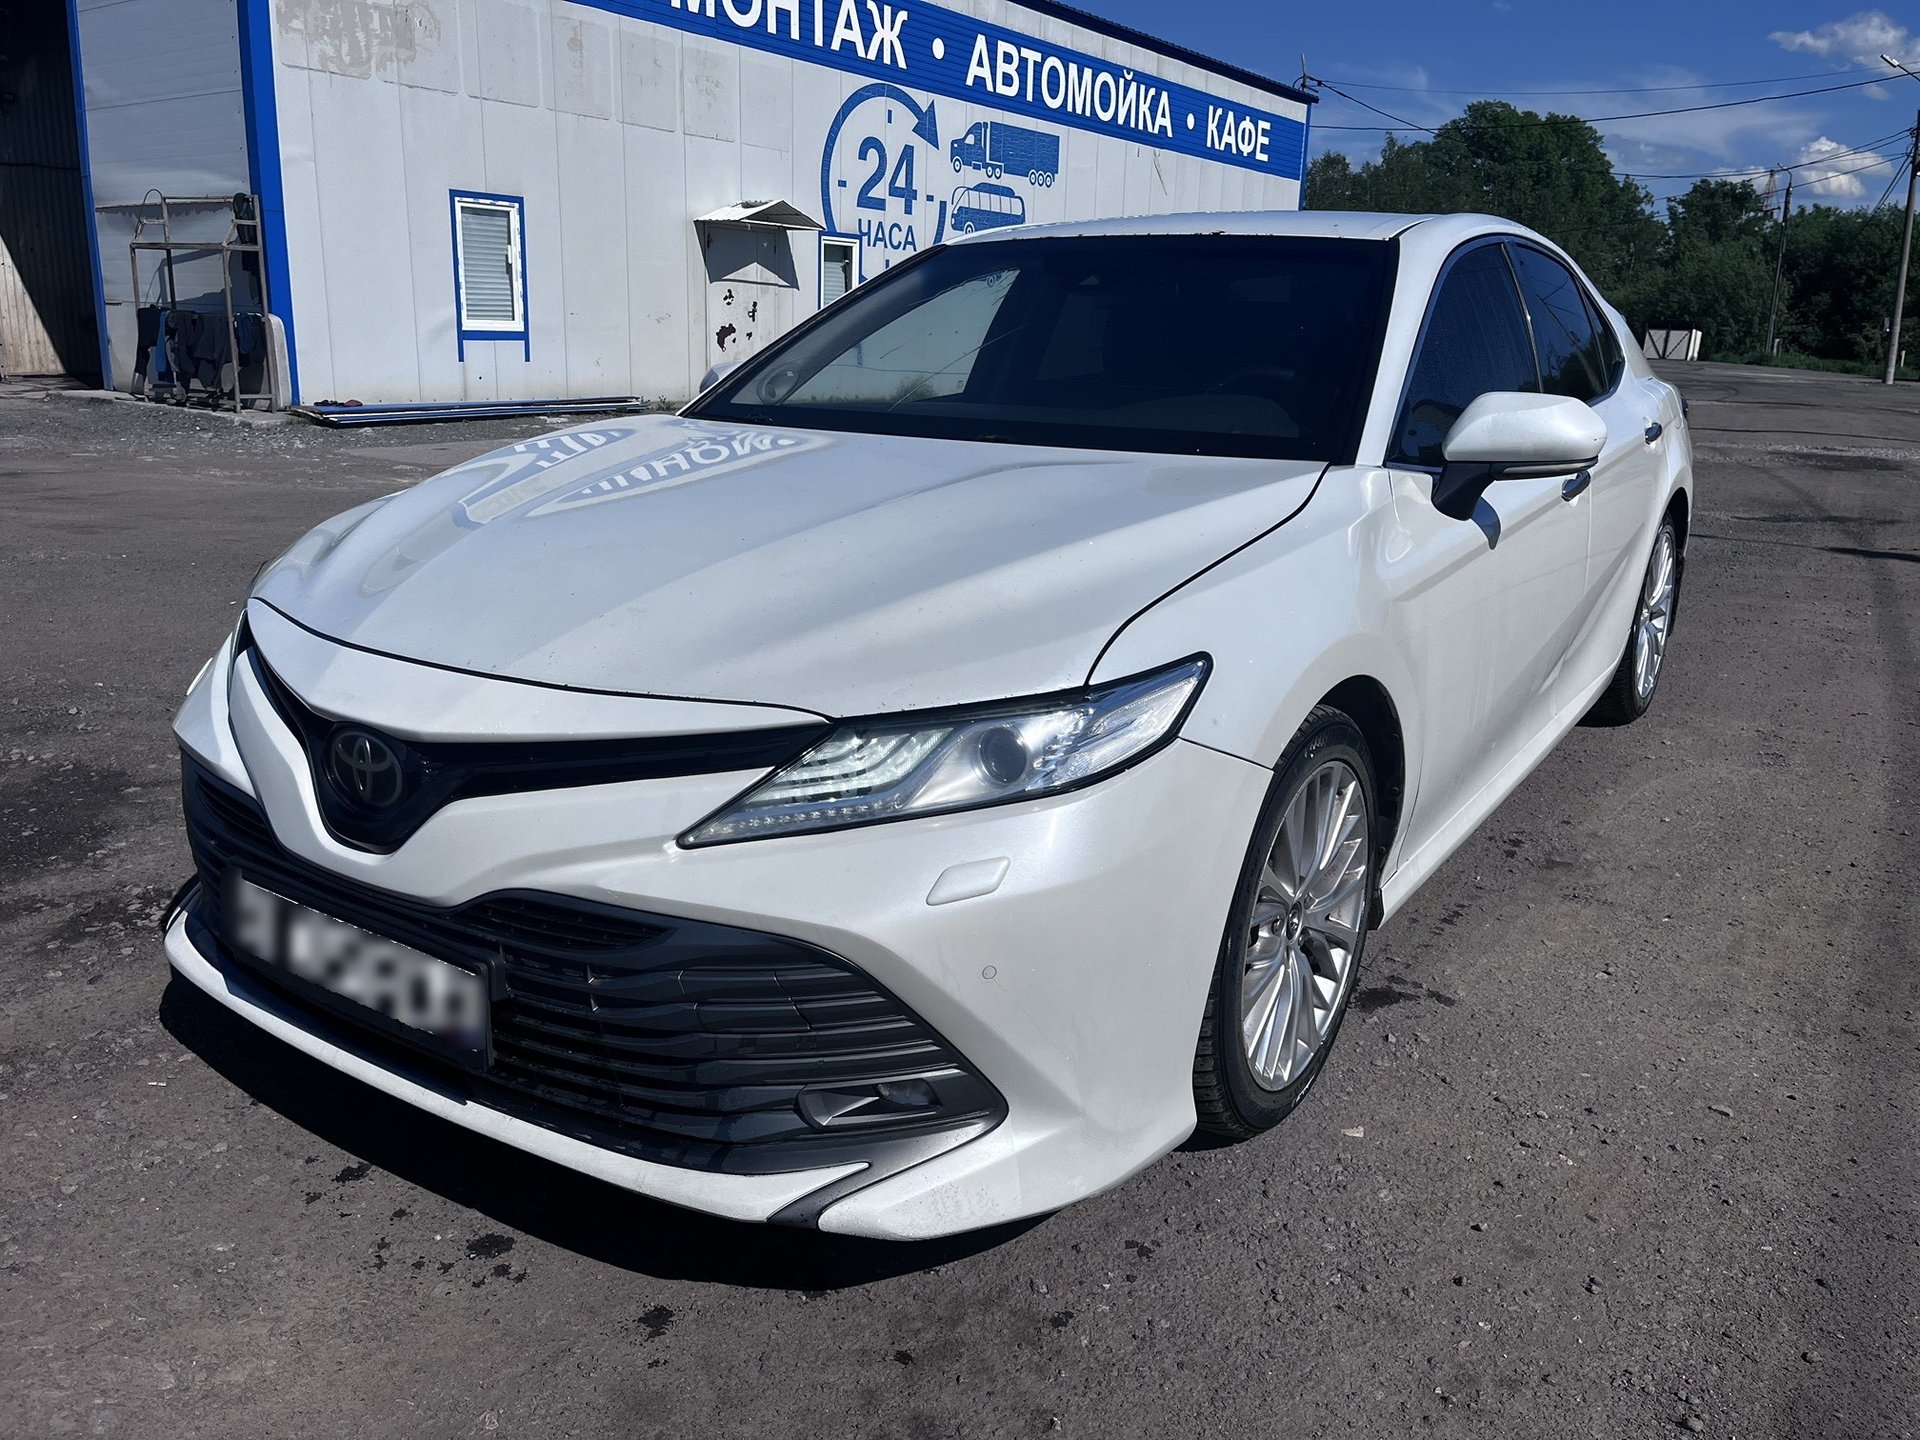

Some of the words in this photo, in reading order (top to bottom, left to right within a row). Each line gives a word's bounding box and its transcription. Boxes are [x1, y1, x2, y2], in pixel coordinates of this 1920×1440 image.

[670, 0, 908, 69] НТАЖ
[965, 33, 1173, 138] АВТОМОЙКА
[1206, 105, 1271, 162] КАФЕ
[856, 136, 918, 215] 24
[858, 218, 917, 252] ЧАСА
